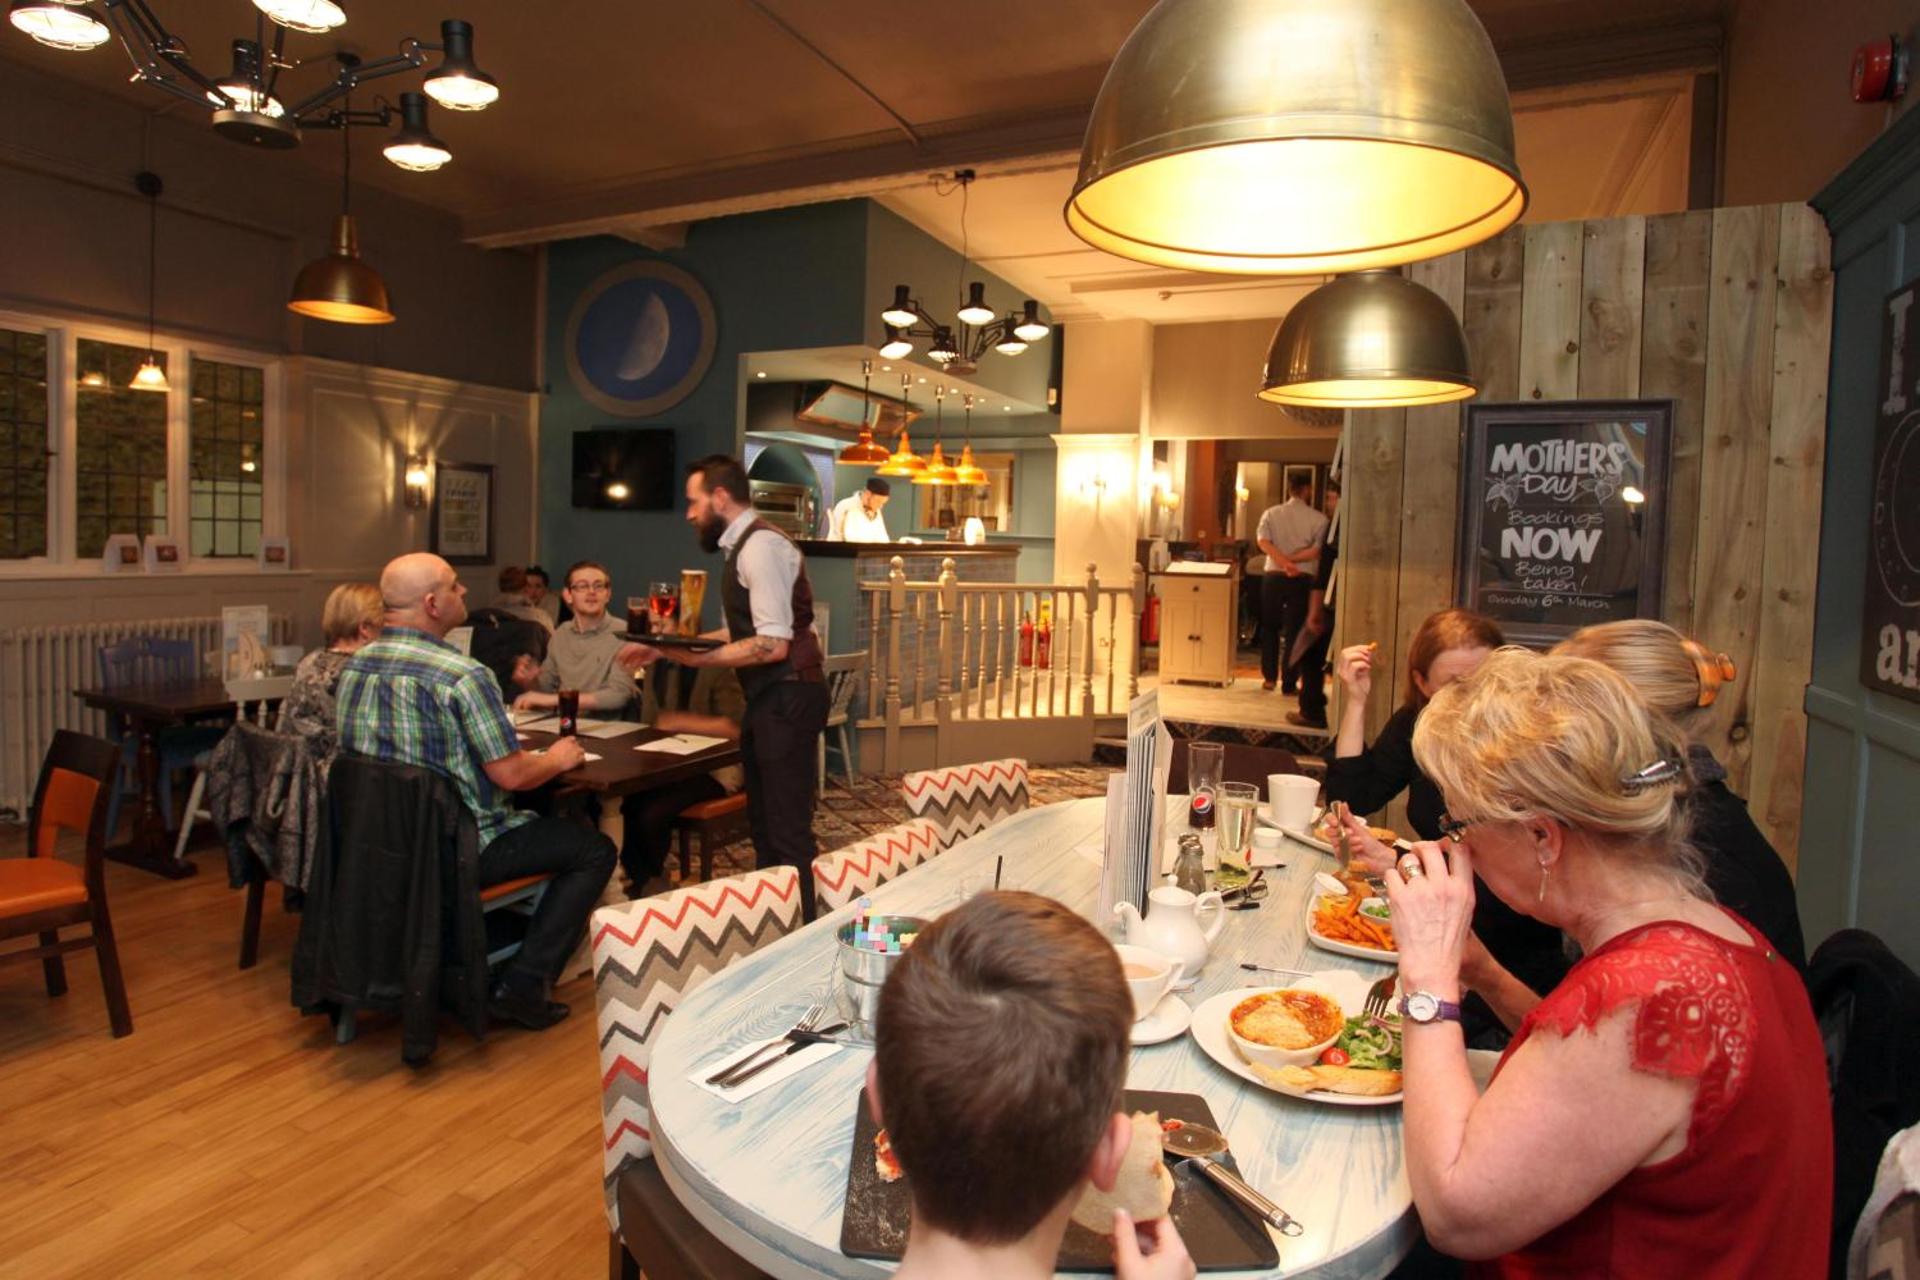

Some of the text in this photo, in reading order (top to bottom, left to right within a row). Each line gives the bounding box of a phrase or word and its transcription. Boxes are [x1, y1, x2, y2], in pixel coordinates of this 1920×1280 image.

[1490, 439, 1625, 474] MOTHERS
[1522, 474, 1578, 502] Day
[1508, 510, 1604, 529] Bookings
[1501, 526, 1602, 563] NOW
[1515, 561, 1574, 580] Being
